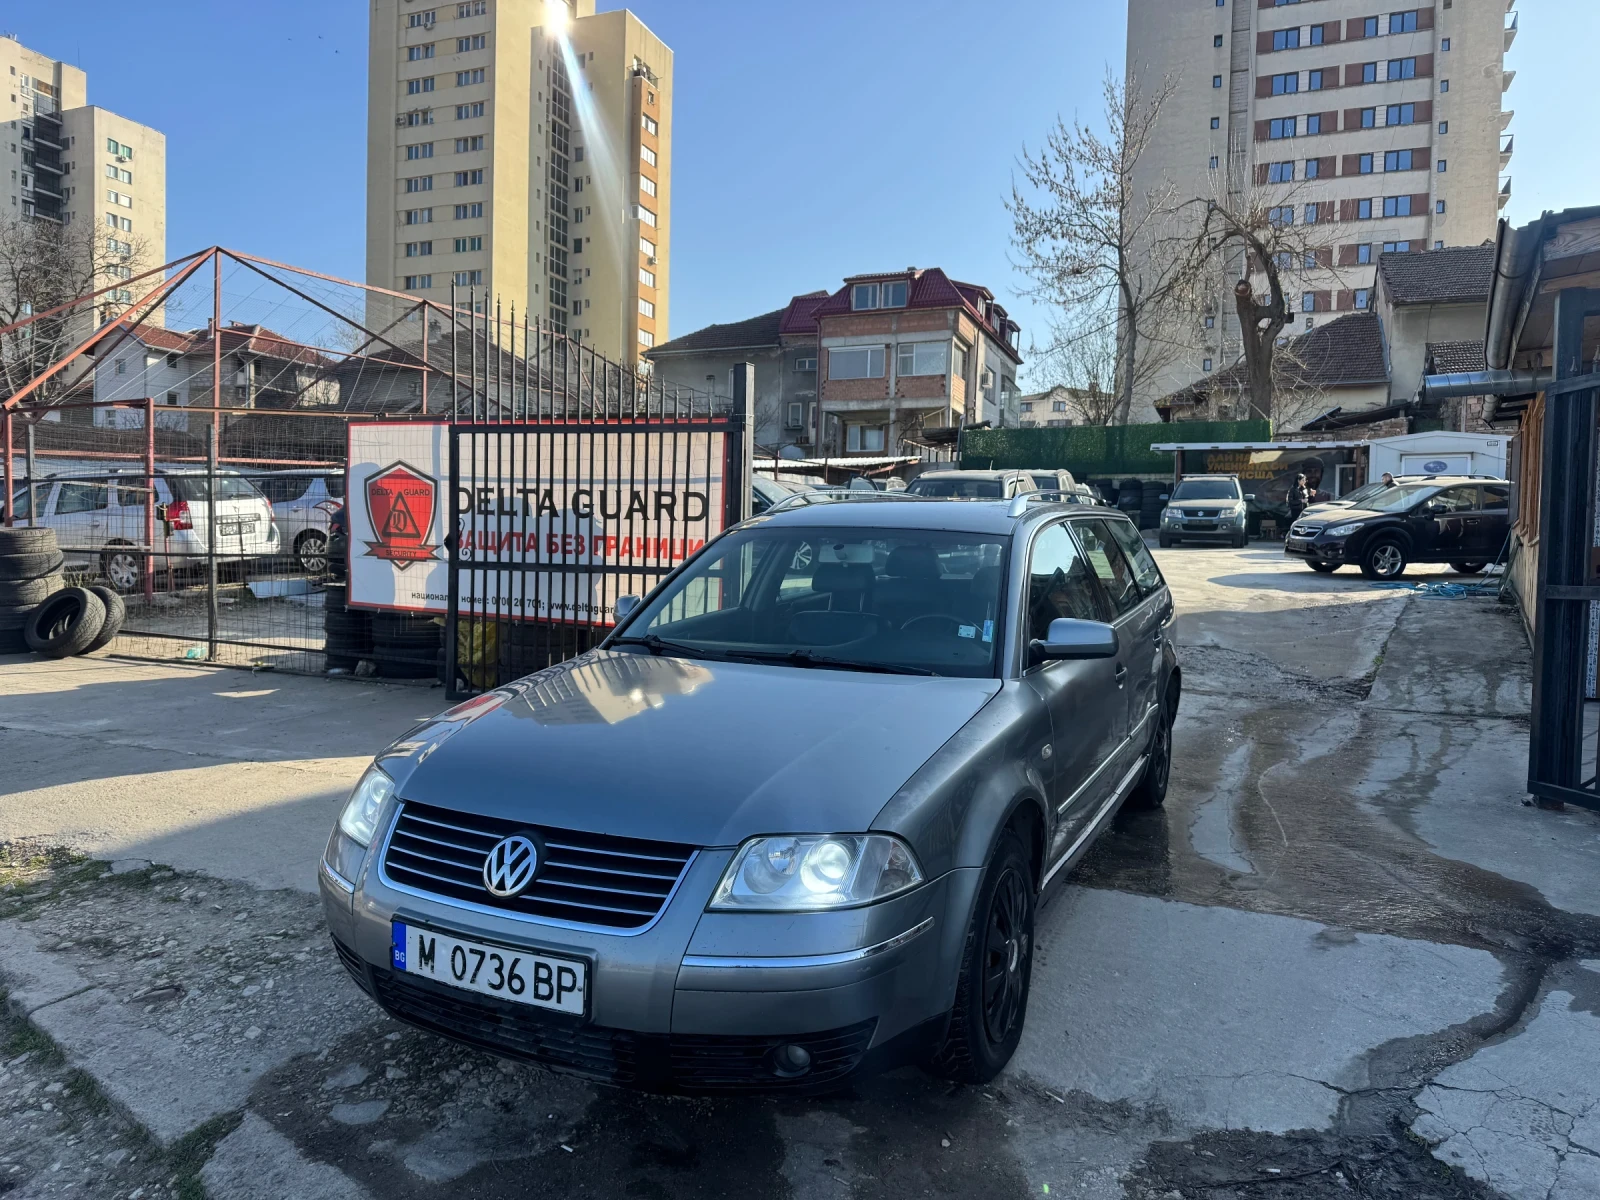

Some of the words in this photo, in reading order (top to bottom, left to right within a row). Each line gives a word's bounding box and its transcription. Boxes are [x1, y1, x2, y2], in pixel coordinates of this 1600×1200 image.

[371, 488, 394, 496] DELTA
[403, 488, 431, 496] GUARD
[457, 486, 560, 518] DELTA
[571, 488, 707, 522] GUARD
[546, 533, 586, 555] БЕЗ
[385, 549, 417, 557] SECURITY
[411, 591, 449, 601] национал
[461, 596, 490, 605] номе:
[394, 950, 406, 963] BG
[450, 944, 526, 995] 0736
[533, 961, 577, 1004] BP
